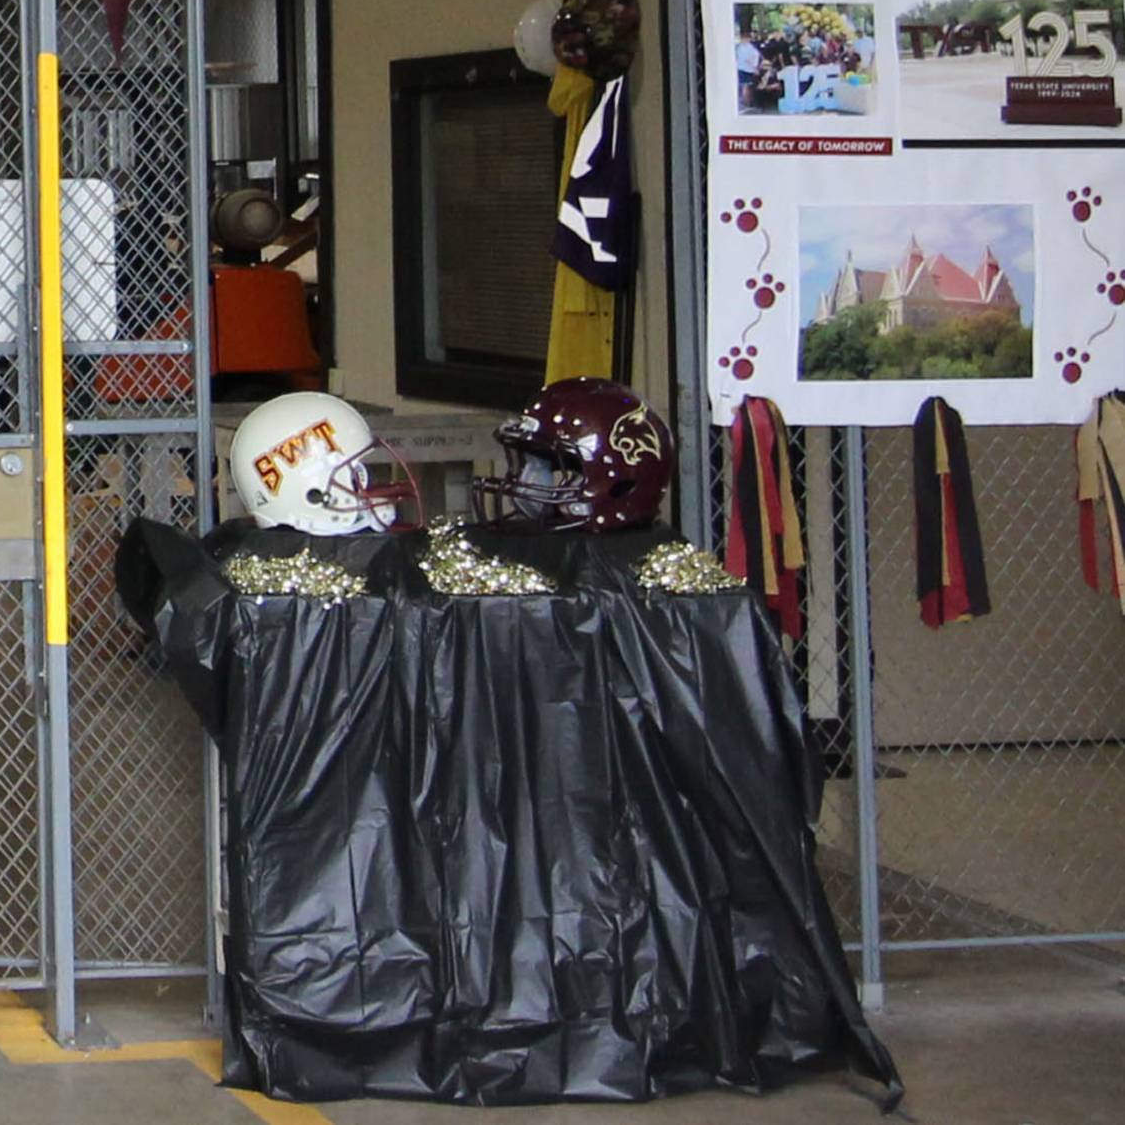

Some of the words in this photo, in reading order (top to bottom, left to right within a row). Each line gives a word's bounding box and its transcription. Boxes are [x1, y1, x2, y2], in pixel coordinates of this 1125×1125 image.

[998, 10, 1117, 78] 125
[777, 63, 840, 114] 125
[1011, 82, 1034, 90] TEXAS
[1037, 82, 1059, 90] STATE
[1061, 82, 1110, 91] UNIVERSITY
[728, 139, 748, 150] THE
[752, 139, 795, 151] LEGACY
[798, 140, 813, 151] OF
[818, 140, 885, 152] TOMORROW
[253, 419, 344, 496] SWT
